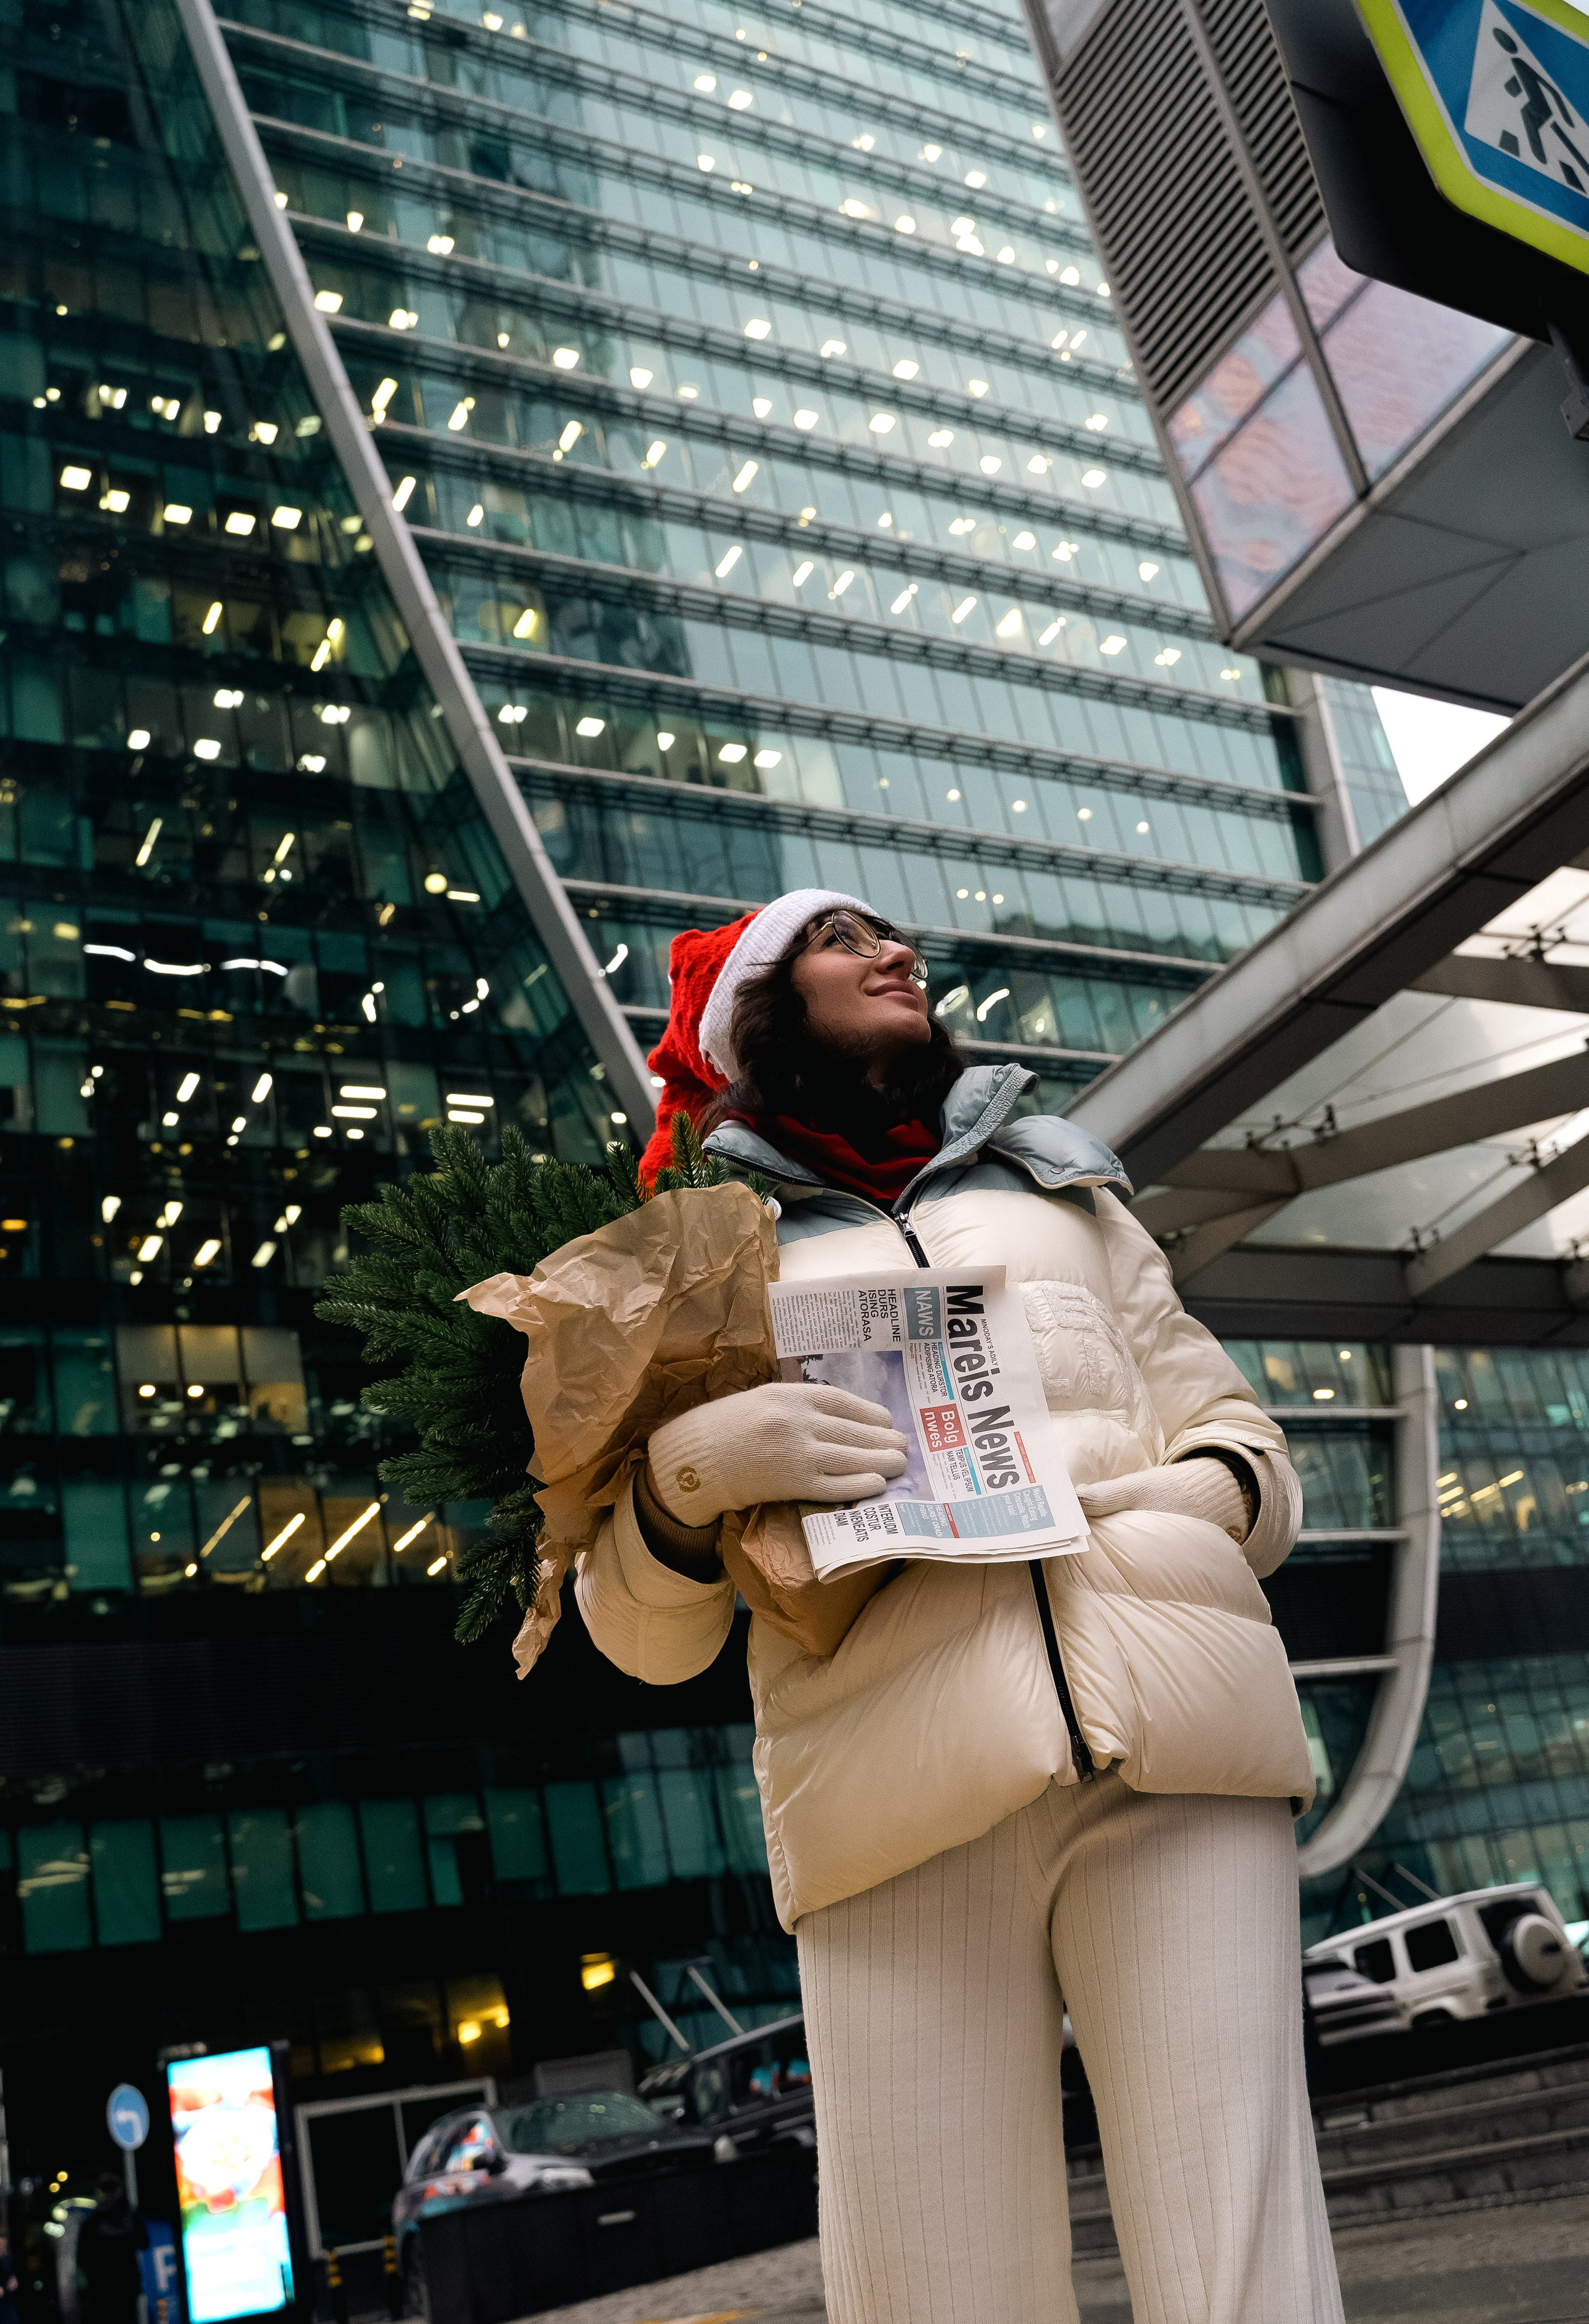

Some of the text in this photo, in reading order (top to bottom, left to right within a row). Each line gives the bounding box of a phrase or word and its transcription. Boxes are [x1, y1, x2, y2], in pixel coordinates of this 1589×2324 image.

[858, 1290, 871, 1342] ATORASA
[868, 1290, 878, 1317] ISING
[878, 1290, 888, 1319] DURS
[888, 1289, 901, 1342] HEADLINE
[916, 1291, 934, 1336] NAWS
[946, 1285, 1000, 1401] Mareis
[980, 1319, 998, 1366] MNODAY'S ADILY
[924, 1342, 934, 1373] ADIPISING
[929, 1374, 938, 1393] ATORA
[932, 1342, 947, 1397] HEADING DURSTOR
[925, 1412, 942, 1448] nwes
[941, 1411, 960, 1443] Bolg
[946, 1451, 955, 1462] NAM
[956, 1448, 967, 1468] TEMPUS
[967, 1405, 1020, 1489] News
[949, 1462, 960, 1480] TELLUS
[961, 1468, 970, 1478] VEL
[964, 1478, 975, 1492] IPSUM
[918, 1504, 929, 1520] PISING
[926, 1505, 937, 1520] DURST
[1002, 1494, 1012, 1504] your
[1023, 1490, 1038, 1521] Caught Eating
[1032, 1487, 1048, 1517] Weird Reptile
[834, 1513, 849, 1527] DIAM
[849, 1510, 869, 1542] NVENEATIS
[863, 1507, 881, 1532] COSTUR
[878, 1504, 898, 1535] INTERUDM
[935, 1505, 947, 1526] HEADING
[1020, 1514, 1031, 1528] Watch
